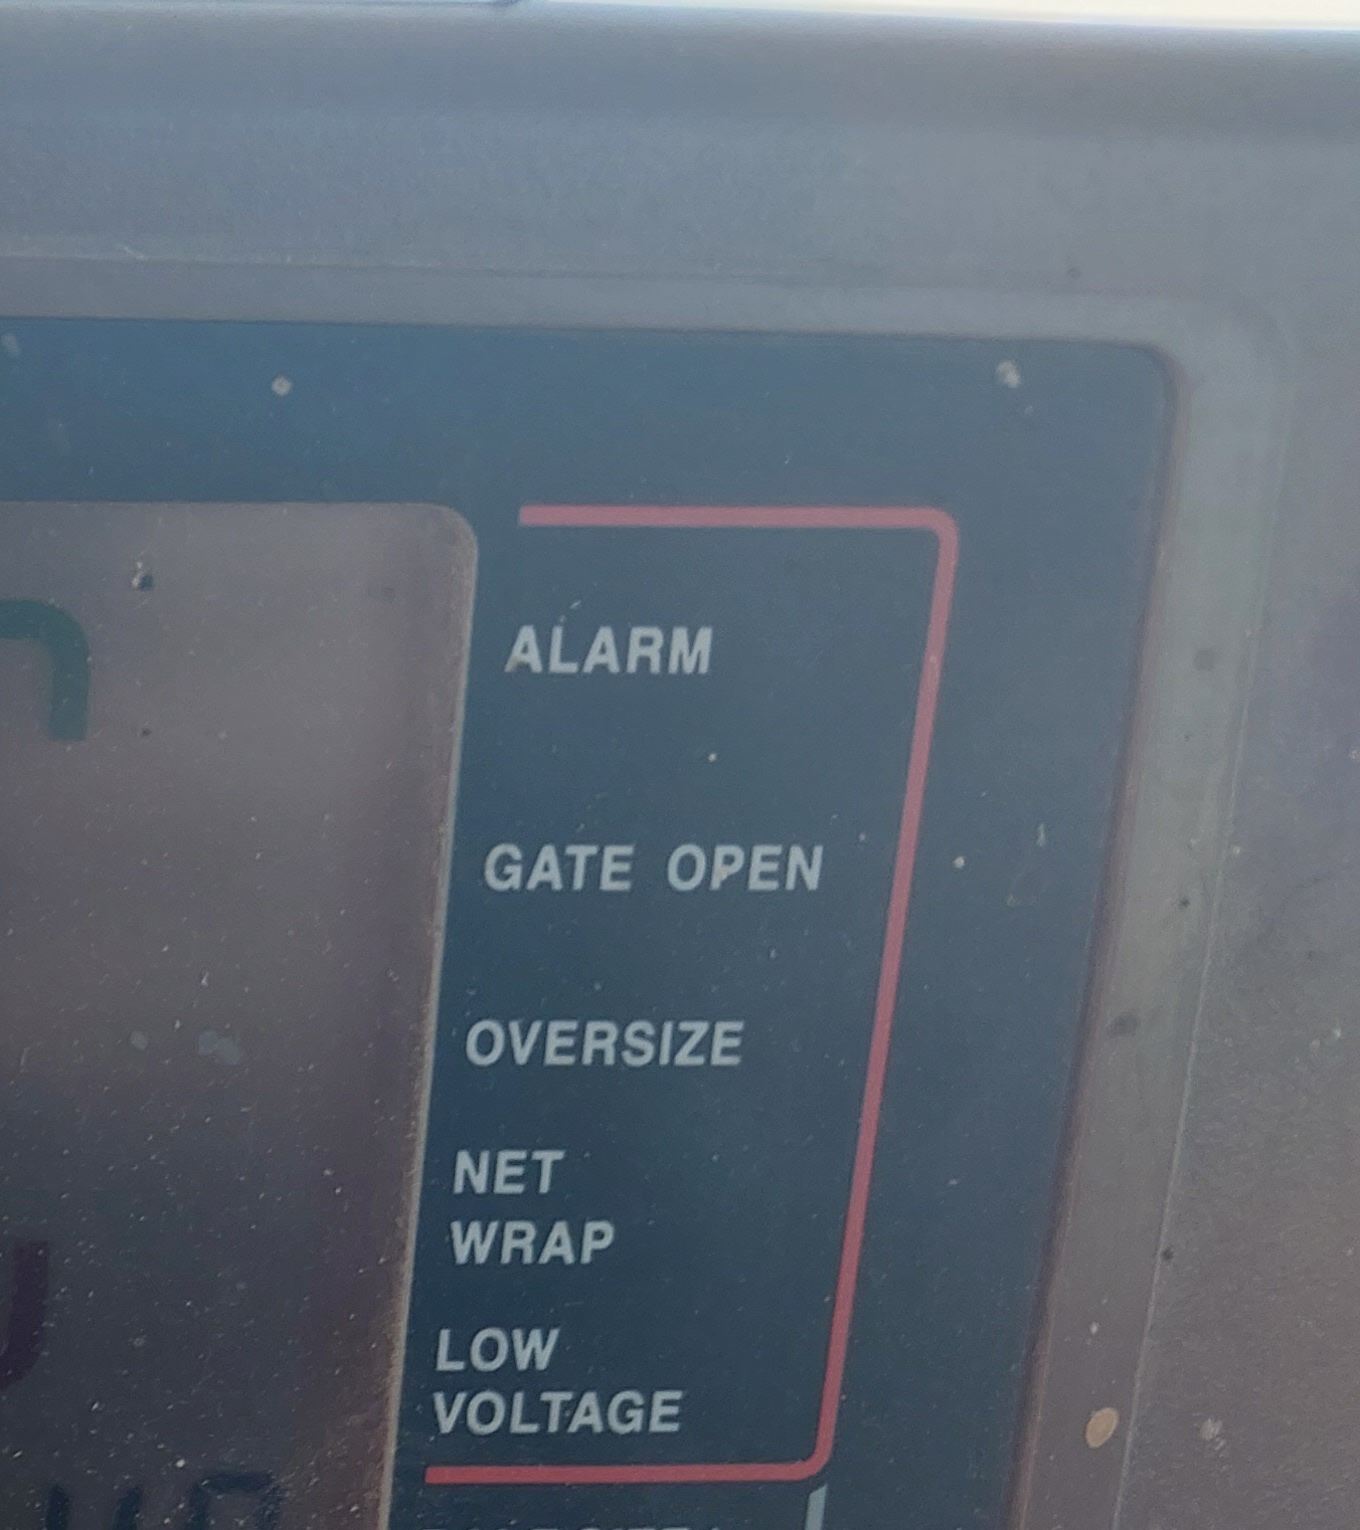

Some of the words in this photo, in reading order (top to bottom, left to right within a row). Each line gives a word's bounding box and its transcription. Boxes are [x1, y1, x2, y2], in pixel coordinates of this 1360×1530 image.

[504, 624, 714, 676] ALARM
[484, 842, 636, 892] GATE
[666, 842, 825, 892] OPEN
[465, 1018, 746, 1068] OVERSIZE
[452, 1148, 566, 1195] NET
[450, 1219, 616, 1266] WRAP
[435, 1326, 561, 1372] LOW
[432, 1389, 685, 1436] VOLTAGE
